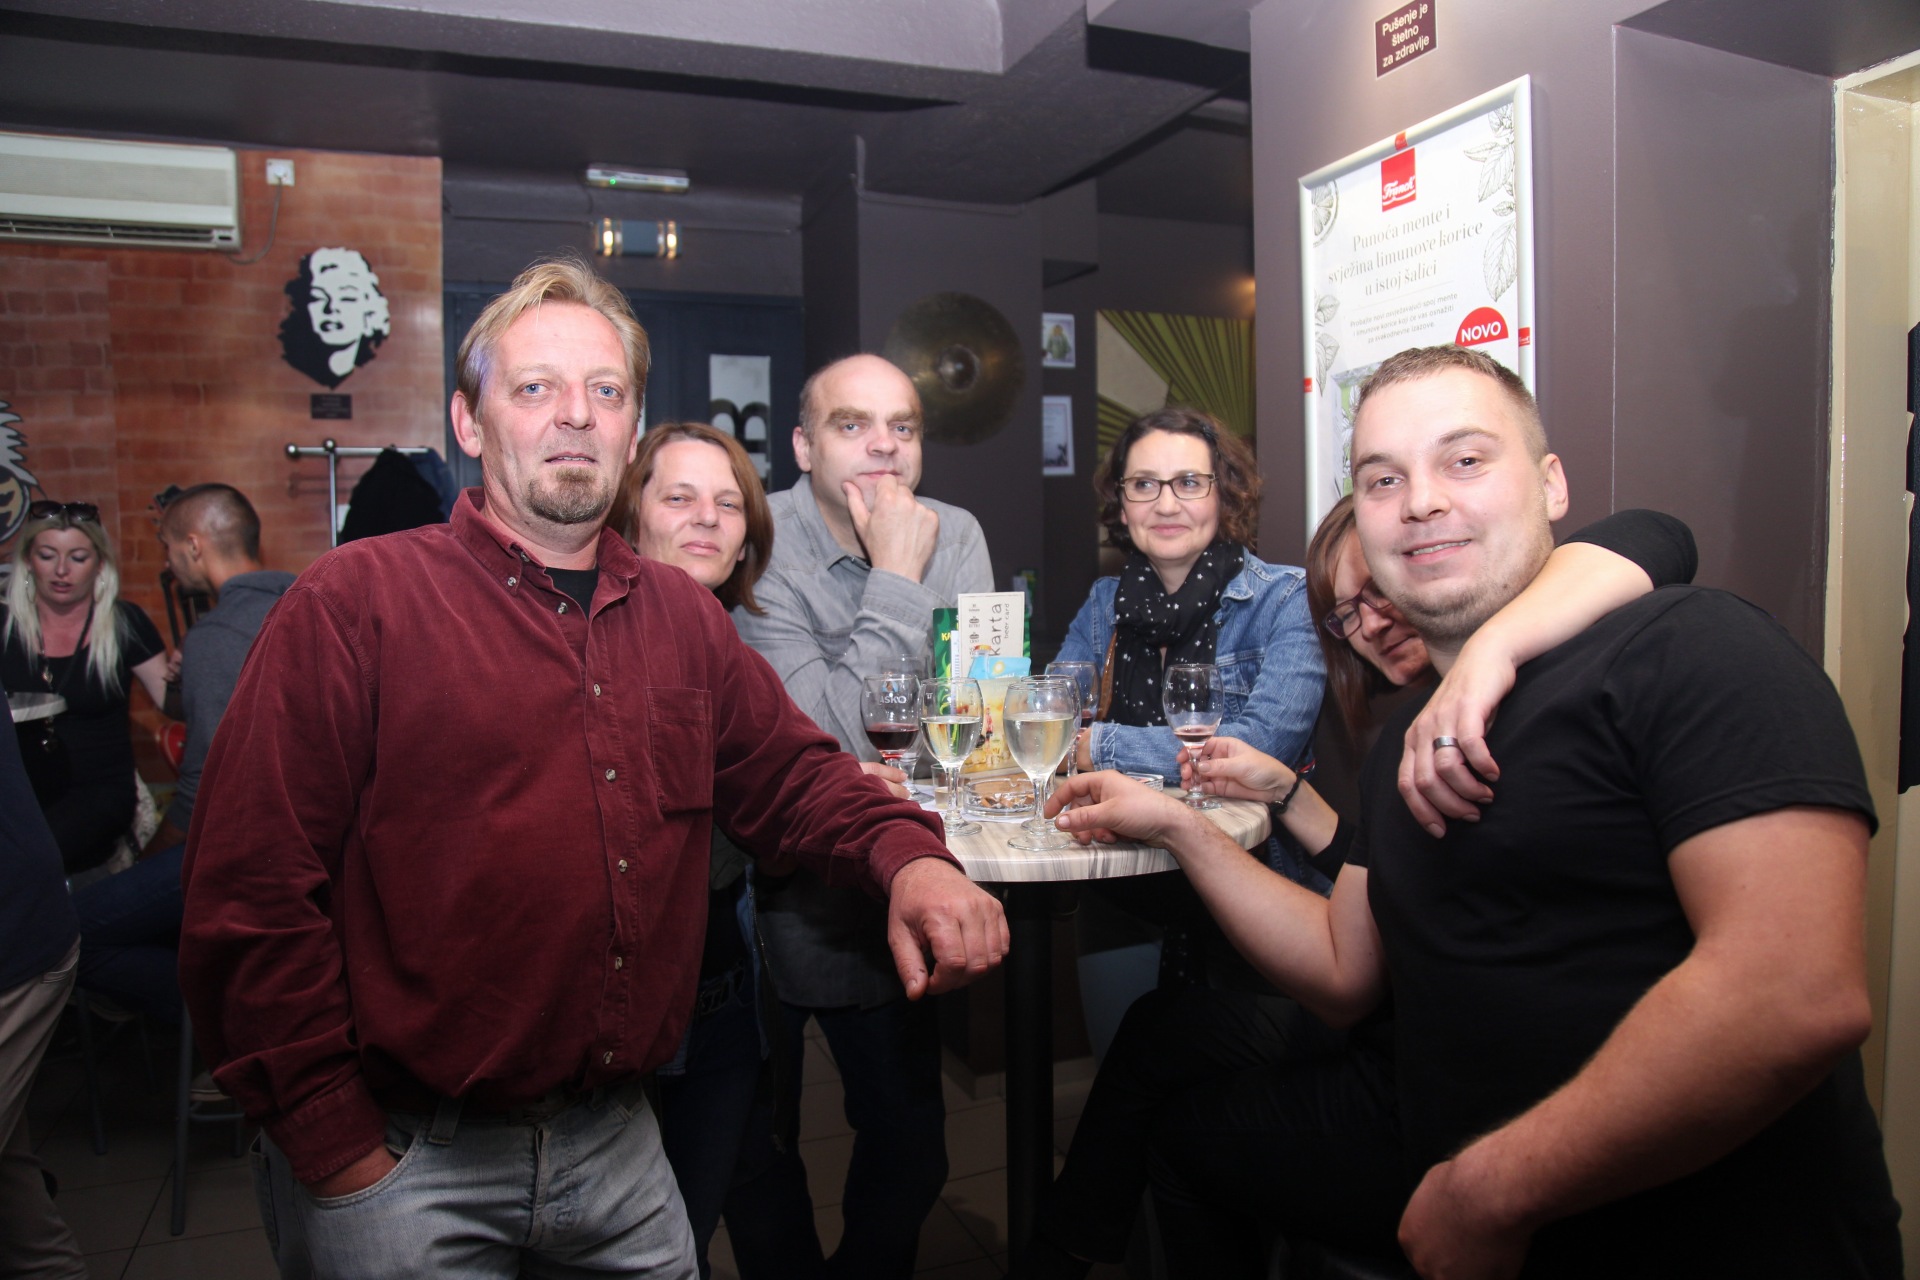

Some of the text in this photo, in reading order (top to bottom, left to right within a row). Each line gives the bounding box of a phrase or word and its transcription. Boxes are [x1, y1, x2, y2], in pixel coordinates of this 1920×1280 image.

[1382, 3, 1428, 36] Pušenje je
[1392, 25, 1419, 47] štetno
[1383, 35, 1430, 68] za zdravlje
[1352, 203, 1450, 252] Punoća mente i
[1328, 222, 1483, 284] svježina limunove korice
[1365, 260, 1437, 296] u istoj šalici
[1461, 321, 1501, 343] NOVO
[989, 603, 1002, 657] karta
